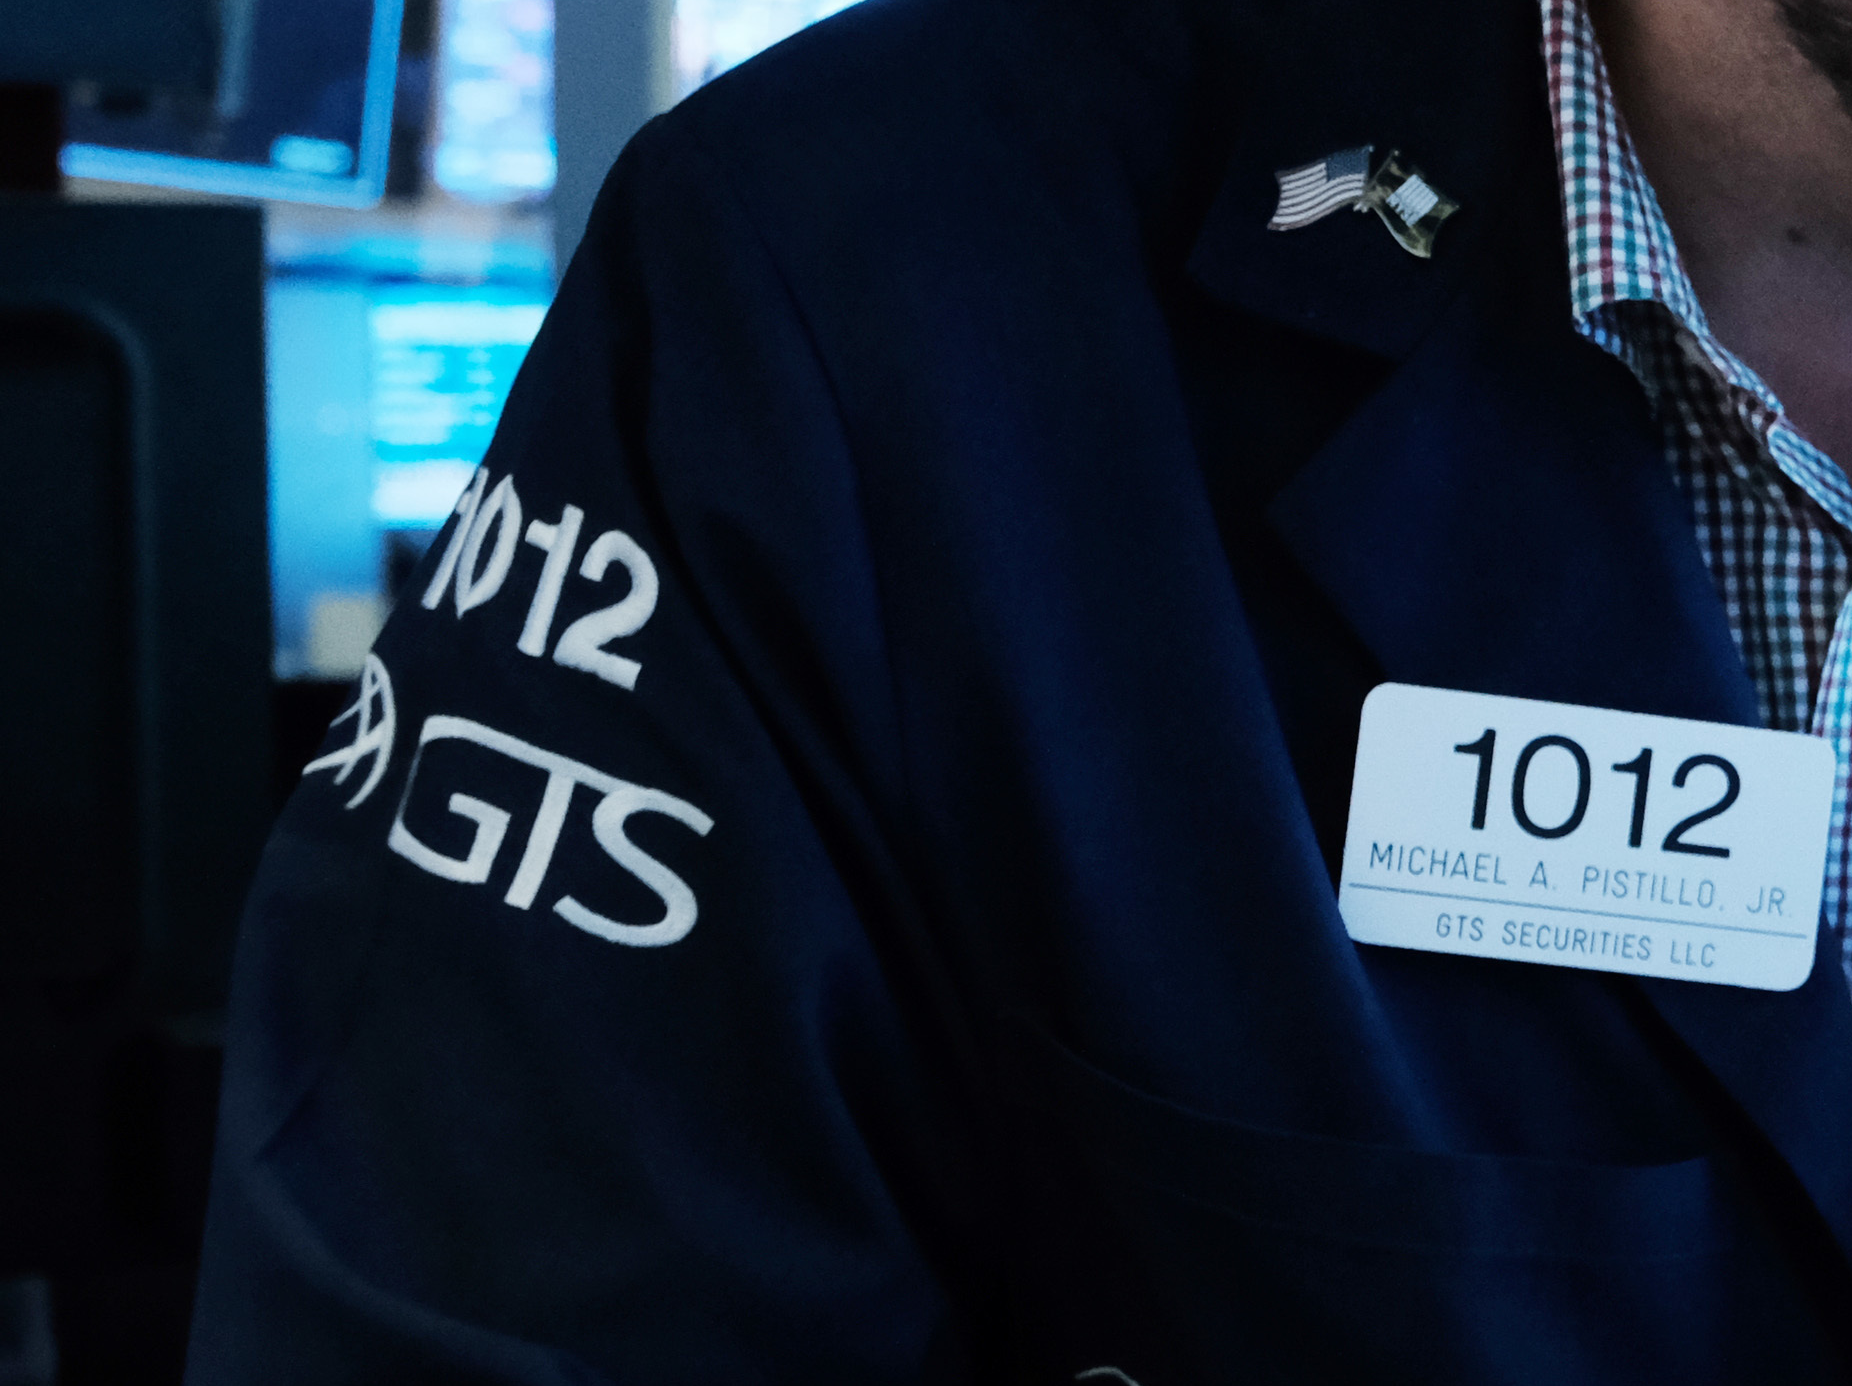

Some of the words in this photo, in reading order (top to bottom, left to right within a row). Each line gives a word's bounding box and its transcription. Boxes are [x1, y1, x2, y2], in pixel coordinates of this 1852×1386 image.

[421, 466, 659, 691] 1012
[388, 715, 715, 948] GTS
[1454, 728, 1742, 858] 1012
[1369, 841, 1507, 887] MICHAEL
[1529, 860, 1559, 890] A.
[1436, 912, 1484, 942] GTS
[1501, 921, 1652, 962] SECURITIES
[1670, 941, 1717, 968] LLC
